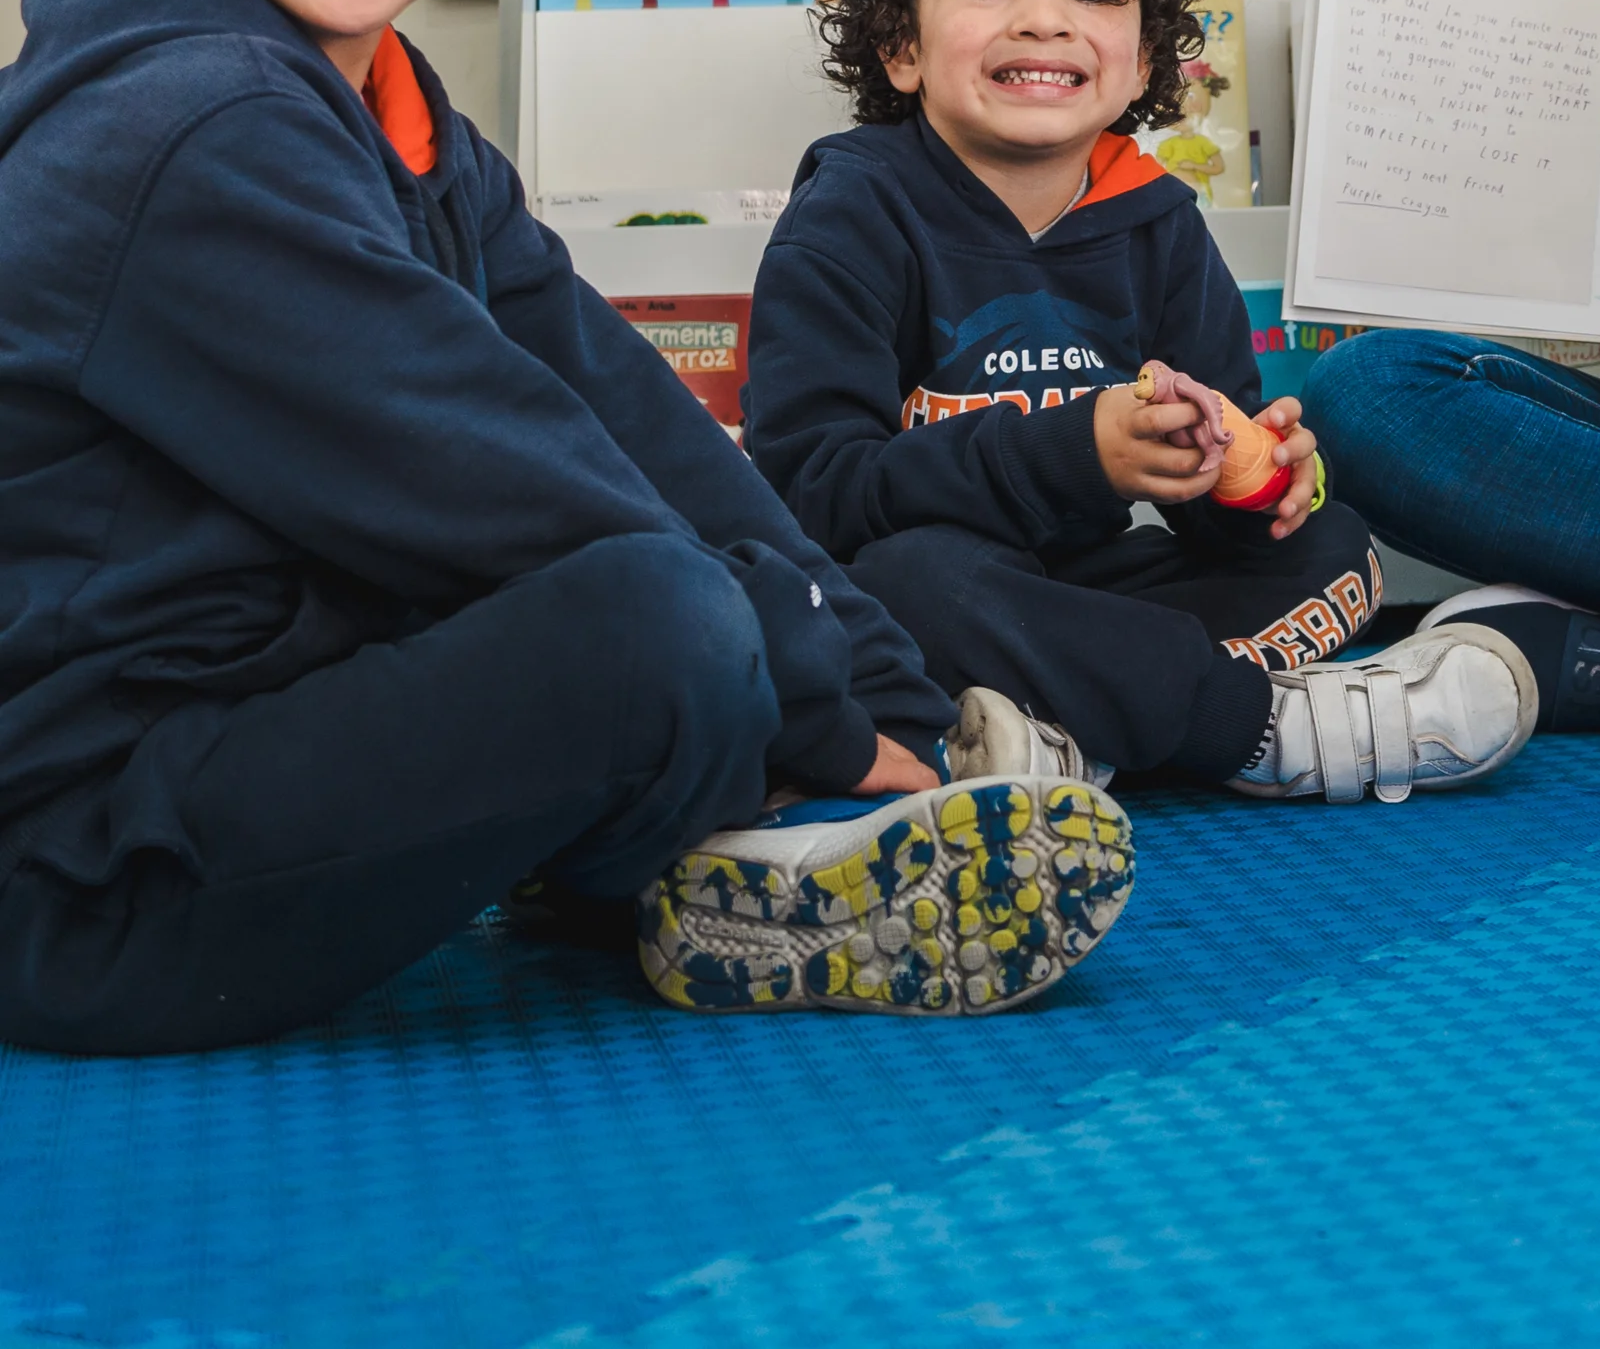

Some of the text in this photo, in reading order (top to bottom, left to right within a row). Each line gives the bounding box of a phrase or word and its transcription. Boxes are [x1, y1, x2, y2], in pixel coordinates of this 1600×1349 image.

[1474, 11, 1499, 27] your
[1561, 25, 1599, 43] crayon
[1376, 48, 1393, 64] my
[1407, 51, 1457, 70] gorgeous
[1467, 63, 1497, 81] color
[1507, 72, 1535, 86] goes
[1394, 31, 1429, 47] makes
[1440, 39, 1455, 51] me
[1468, 45, 1501, 64] crazy
[1508, 52, 1534, 67] that
[1542, 59, 1556, 70] so
[1562, 60, 1593, 77] much
[1344, 79, 1572, 123] COLORING INSIDE the lines
[1346, 61, 1364, 75] the
[1457, 79, 1483, 97] you
[1492, 85, 1536, 103] DON'T
[1547, 91, 1593, 113] START
[1415, 110, 1436, 125] I'm
[1451, 118, 1489, 138] going
[1505, 124, 1518, 137] to
[1344, 120, 1450, 154] COMPLETELY
[1478, 145, 1520, 165] LOSE
[1345, 153, 1450, 185] Your very neat
[1342, 182, 1384, 203] Purple
[633, 324, 738, 348] ormenta
[662, 348, 730, 372] arroz
[984, 347, 1105, 376] COLEGIO
[1219, 534, 1384, 672] TERRA
